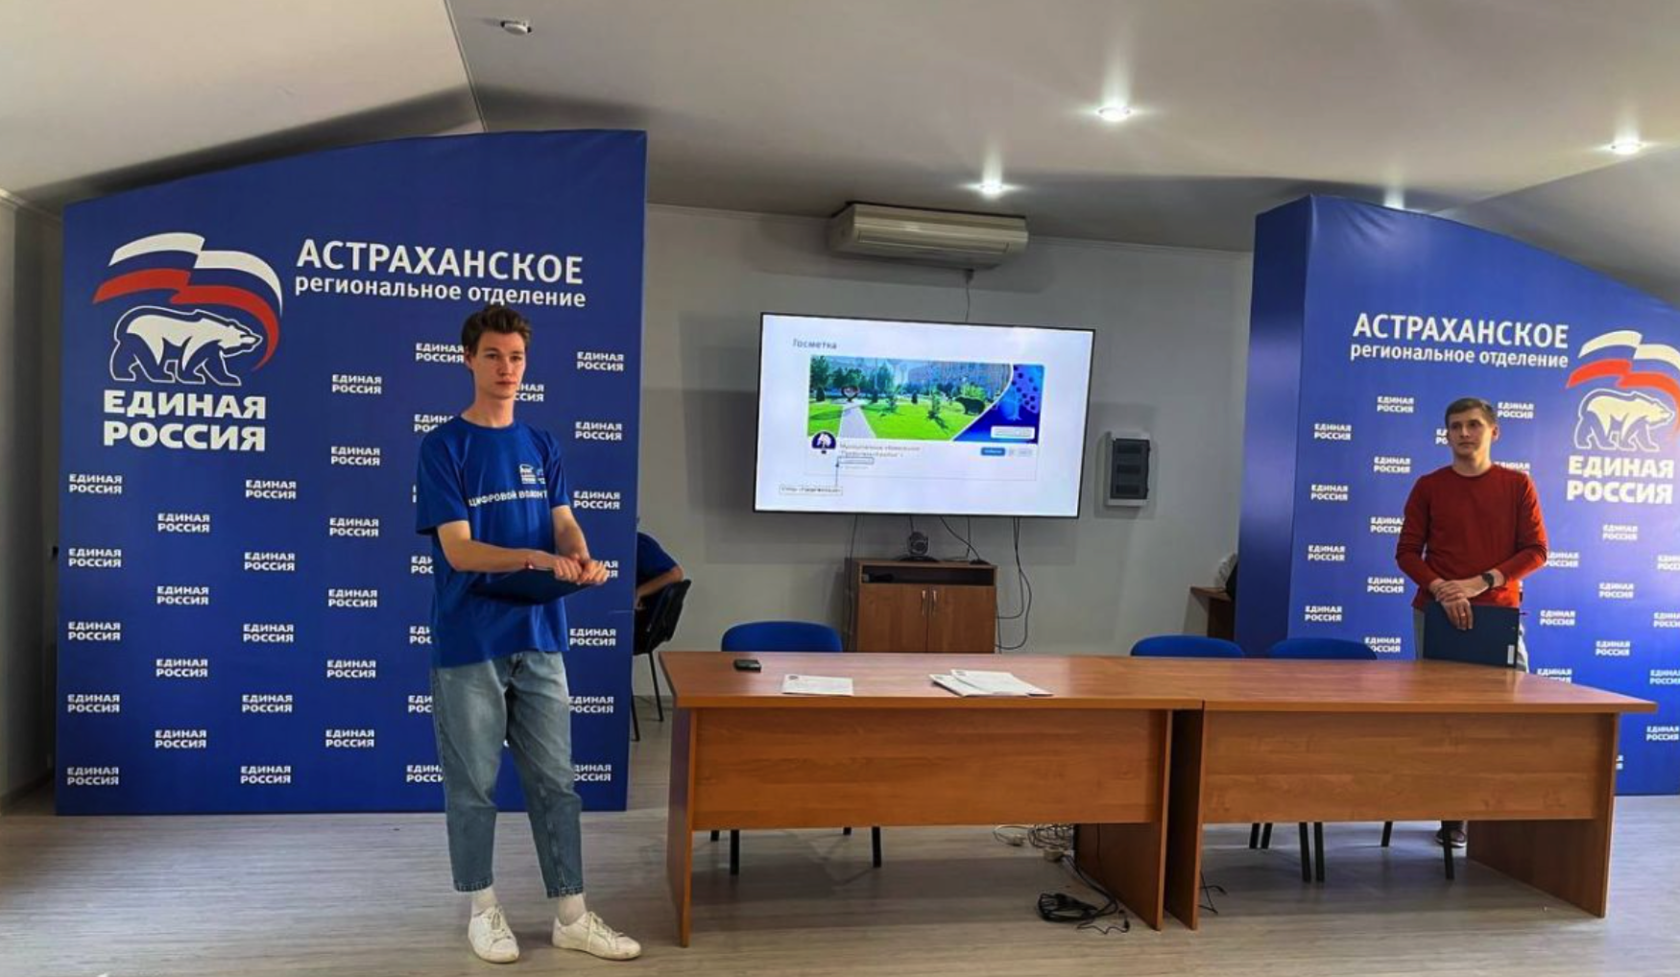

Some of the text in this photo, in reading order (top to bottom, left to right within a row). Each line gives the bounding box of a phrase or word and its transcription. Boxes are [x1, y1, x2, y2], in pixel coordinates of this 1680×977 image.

[296, 238, 584, 285] АСТРАХАНСКОЕ
[295, 275, 587, 308] региональное отделение
[1353, 312, 1569, 349] АСТРАХАНСКОЕ
[415, 343, 465, 354] ЕДИНАЯ
[415, 352, 464, 363] РОССИЯ
[577, 351, 624, 361] ЕДИНАЯ
[1350, 342, 1569, 369] региональное отделение
[577, 361, 624, 371] РОССИЯ
[332, 374, 382, 384] ЕДИНАЯ
[332, 384, 382, 394] РОССИЯ
[522, 384, 544, 392] НАЯ
[515, 393, 544, 402] ССИЯ
[1377, 396, 1414, 405] ЕДИНАЯ
[103, 389, 267, 420] ЕДИНАЯ
[1377, 405, 1414, 414] РОССИЯ
[414, 414, 453, 424] ЕДИН
[575, 421, 623, 431] ЕДИНАЯ
[1314, 423, 1352, 432] ЕДИНАЯ
[103, 420, 266, 452] РОССИЯ
[575, 430, 623, 440] РОССИЯ
[1314, 432, 1352, 441] РОССИЯ
[330, 446, 381, 456] ЕДИНАЯ
[330, 456, 381, 466] РОССИЯ
[1374, 457, 1411, 466] ЕДИНАЯ
[1374, 465, 1411, 474] РОССИЯ
[1568, 455, 1675, 478] ЕДИНАЯ
[69, 473, 123, 484] ЕДИНАЯ
[69, 483, 123, 494] РОССИЯ
[245, 480, 297, 490] ЕДИНАЯ
[1311, 484, 1348, 493] ЕДИНАЯ
[245, 490, 297, 500] РОССИЯ
[573, 490, 621, 500] ЕДИНАЯ
[1311, 492, 1348, 501] РОССИЯ
[1566, 480, 1673, 504] РОССИЯ
[573, 499, 621, 509] РОССИЯ
[157, 513, 211, 523] ЕДИНАЯ
[329, 517, 380, 527] ЕДИНАЯ
[157, 523, 211, 533] РОССИЯ
[329, 527, 380, 537] РОССИЯ
[68, 548, 122, 558] ЕДИНАЯ
[1308, 545, 1345, 554] ЕДИНАЯ
[244, 551, 296, 561] ЕДИНАЯ
[1308, 553, 1345, 562] РОССИЯ
[68, 558, 122, 568] РОССИЯ
[244, 561, 296, 571] РОССИЯ
[411, 565, 434, 575] РОС
[1367, 577, 1404, 586] ЕДИНАЯ
[157, 586, 210, 596] ЕДИНАЯ
[328, 589, 378, 599] ЕДИНАЯ
[1367, 585, 1404, 594] РОССИЯ
[157, 596, 210, 606] РОССИЯ
[328, 598, 378, 608] РОССИЯ
[1305, 605, 1343, 614] ЕДИНАЯ
[1305, 613, 1343, 622] РОССИЯ
[68, 621, 121, 631] ЕДИНАЯ
[243, 624, 294, 634] ЕДИНАЯ
[68, 631, 121, 641] РОССИЯ
[569, 628, 617, 637] ЕДИНАЯ
[243, 633, 294, 643] РОССИЯ
[569, 637, 617, 646] РОССИЯ
[155, 658, 208, 668] ЕДИНАЯ
[327, 660, 376, 670] ЕДИНАЯ
[155, 668, 208, 678] РОССИЯ
[327, 669, 376, 679] РОССИЯ
[67, 694, 120, 704] ЕДИНАЯ
[241, 695, 293, 704] ЕДИНАЯ
[408, 695, 433, 704] ЕДИ
[67, 703, 120, 713] РОССИЯ
[241, 704, 293, 713] РОССИЯ
[408, 704, 432, 713] РОС
[154, 730, 207, 740] ЕДИНАЯ
[325, 730, 375, 739] ЕДИНАЯ
[154, 739, 207, 749] РОССИЯ
[325, 739, 375, 748] РОССИЯ
[67, 767, 119, 777] ЕДИНАЯ
[240, 766, 292, 776] ЕДИНАЯ
[406, 765, 442, 774] ЕДИН
[573, 764, 612, 773] ДИНАЯ
[67, 776, 119, 786] РОССИЯ
[240, 775, 292, 785] РОССИЯ
[574, 773, 611, 782] ОССИЯ
